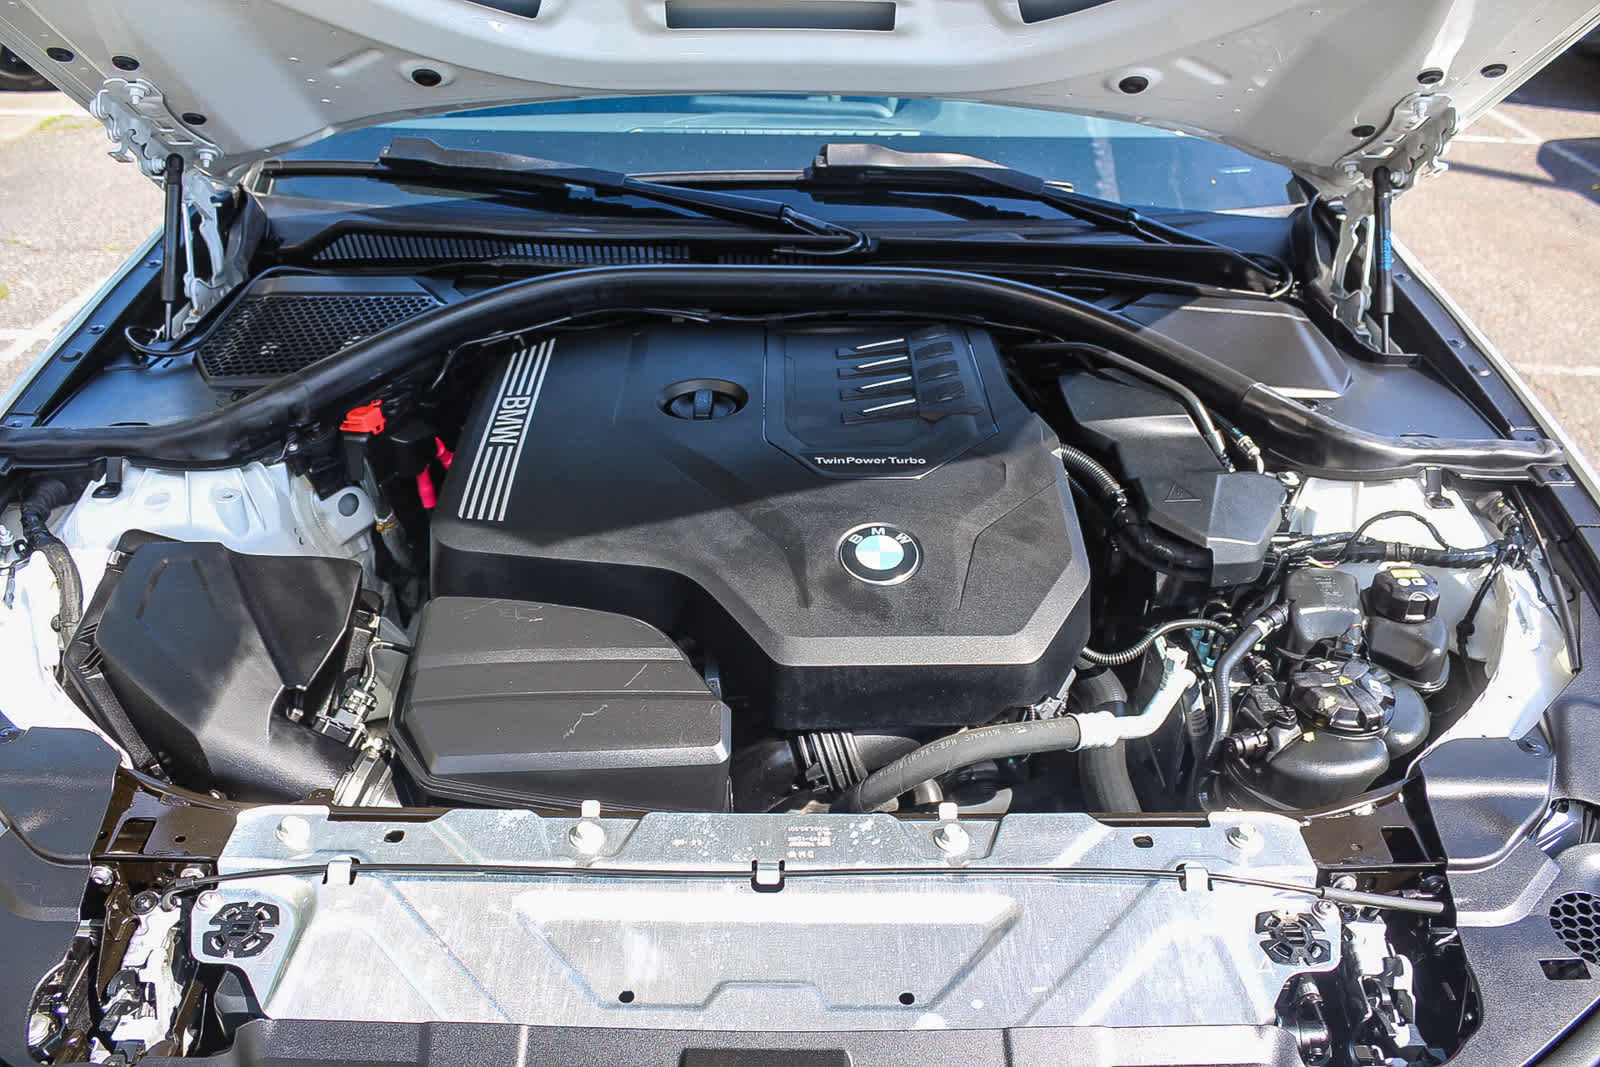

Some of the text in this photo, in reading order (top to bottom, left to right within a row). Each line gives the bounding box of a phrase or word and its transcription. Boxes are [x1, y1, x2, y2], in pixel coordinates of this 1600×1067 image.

[489, 396, 531, 444] BMW
[814, 456, 927, 465] TwinPower Turbo
[847, 527, 913, 545] BMW
